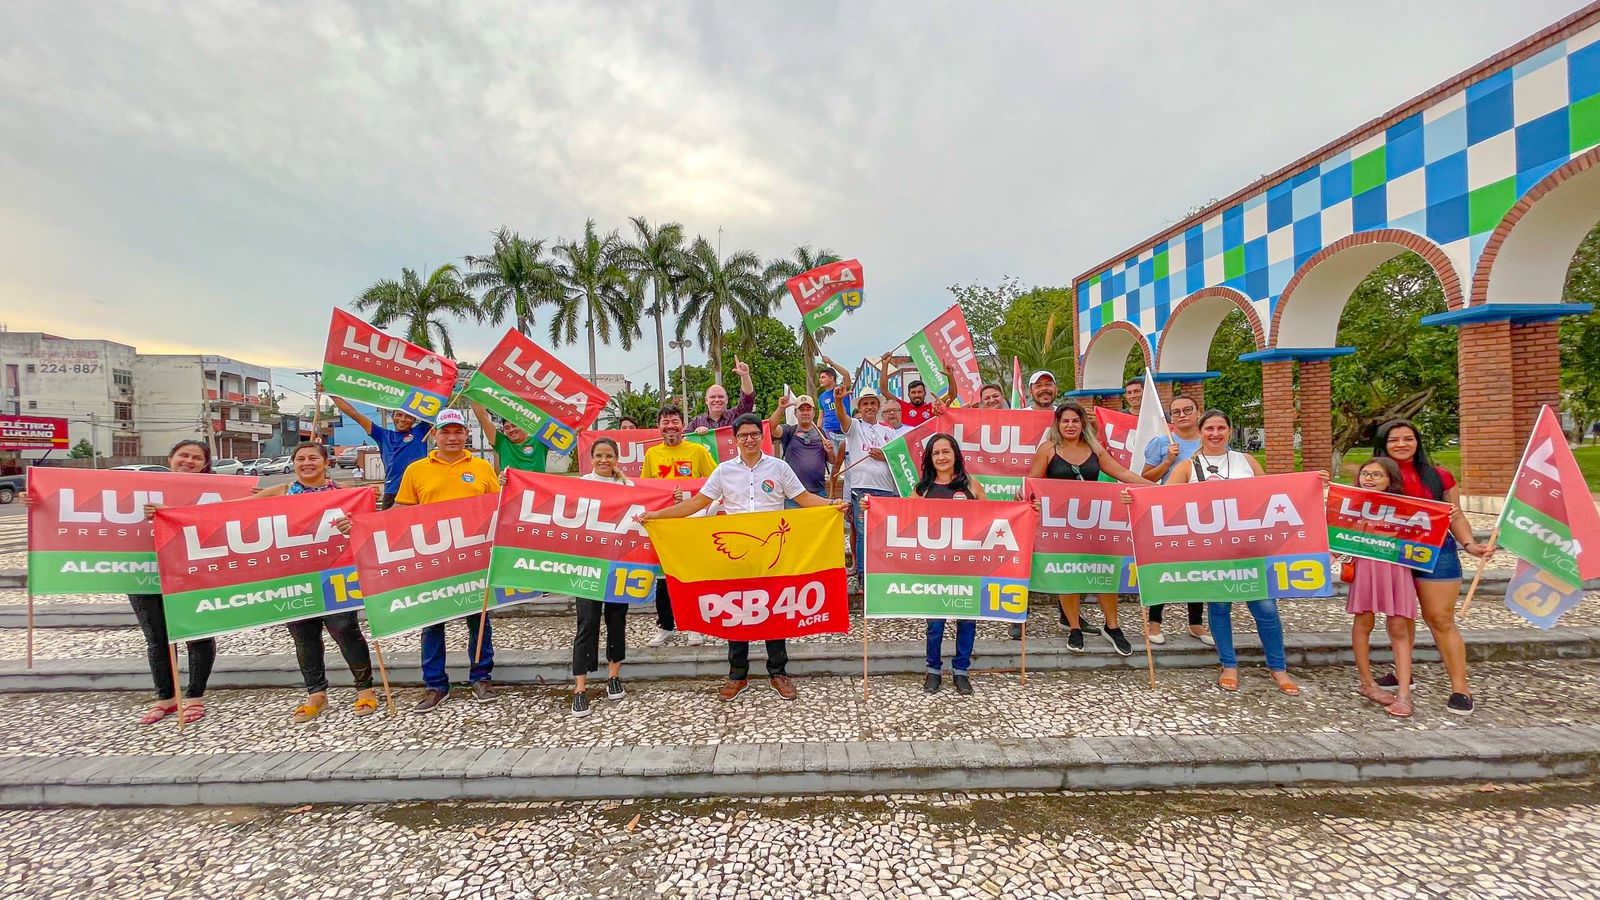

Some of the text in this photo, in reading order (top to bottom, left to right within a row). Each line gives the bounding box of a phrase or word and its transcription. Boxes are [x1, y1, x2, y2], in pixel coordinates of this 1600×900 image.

[798, 267, 857, 299] LULA
[841, 291, 861, 307] 13
[343, 325, 443, 377] LULA
[940, 320, 982, 392] LULA
[340, 350, 442, 384] PRESIDENTE
[503, 346, 589, 415] LULA
[335, 373, 405, 397] ALCKMIN
[409, 391, 441, 417] 13
[481, 386, 542, 424] ALCKMIN
[543, 422, 575, 450] 13
[965, 455, 1031, 465] RESIDE
[518, 490, 650, 537] LULA
[1041, 496, 1131, 531] LUL
[1151, 494, 1304, 537] LULA
[1340, 497, 1431, 530] LULA
[183, 508, 350, 560] LULA
[516, 526, 651, 549] PRESIDENTE
[886, 516, 1020, 551] LULA
[1042, 532, 1132, 544] PRESIDEN
[1154, 531, 1306, 548] PRESIDENTE
[1336, 533, 1396, 549] ALCKMIN
[60, 561, 159, 573] ALCKMI
[188, 544, 345, 575] PRESIDENT
[379, 547, 483, 577] PRESIDE
[886, 552, 1020, 565] PRESIDENTE
[1404, 544, 1432, 563] 13
[512, 557, 601, 579] ALCKMIN
[1044, 562, 1114, 574] ALCKMIN
[1086, 576, 1113, 585] VICE
[1159, 568, 1258, 583] ALCKMIN
[1273, 560, 1326, 591] 13
[389, 578, 487, 612] ALCKMIN
[569, 578, 599, 592] VICE
[613, 567, 655, 598] 13
[886, 583, 973, 596] ALCKMIN
[1224, 582, 1260, 593] VICE
[195, 583, 313, 613] ALCKMIN
[273, 596, 316, 613] VICE
[772, 581, 826, 620] 40
[942, 598, 973, 608] VICE
[987, 583, 1027, 613] 13
[797, 612, 830, 628] ACRE
